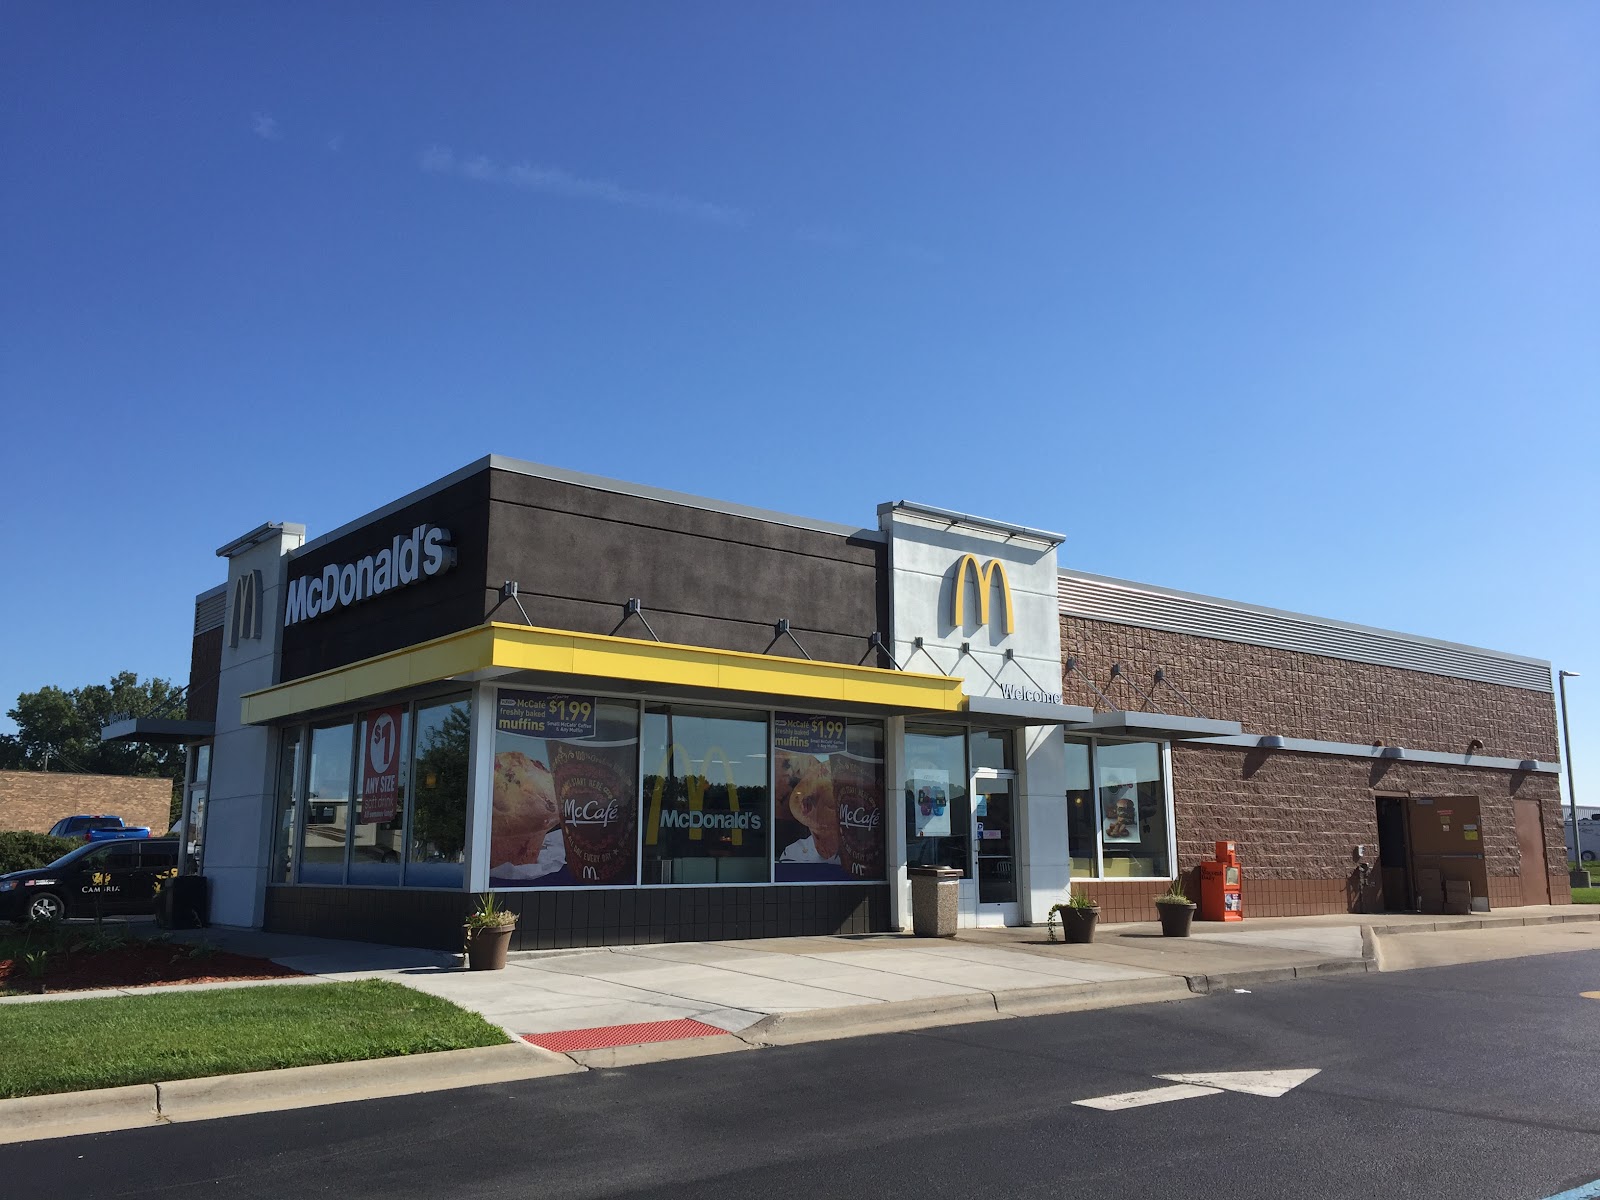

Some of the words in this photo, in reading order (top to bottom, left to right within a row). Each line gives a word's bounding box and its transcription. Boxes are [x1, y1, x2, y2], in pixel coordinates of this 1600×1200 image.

[285, 524, 445, 626] McDonald's
[517, 699, 546, 710] McCafé
[1000, 683, 1062, 705] Welcome
[500, 707, 525, 719] freshly
[525, 709, 546, 718] baked
[548, 699, 592, 722] $1.99
[499, 718, 546, 732] muffins
[811, 720, 844, 739] $1.99
[775, 736, 810, 748] muffins
[365, 776, 380, 795] ANY
[380, 774, 396, 793] SIZE
[564, 798, 619, 827] McCafé
[660, 809, 761, 830] McDonald's
[840, 803, 881, 831] McCafé
